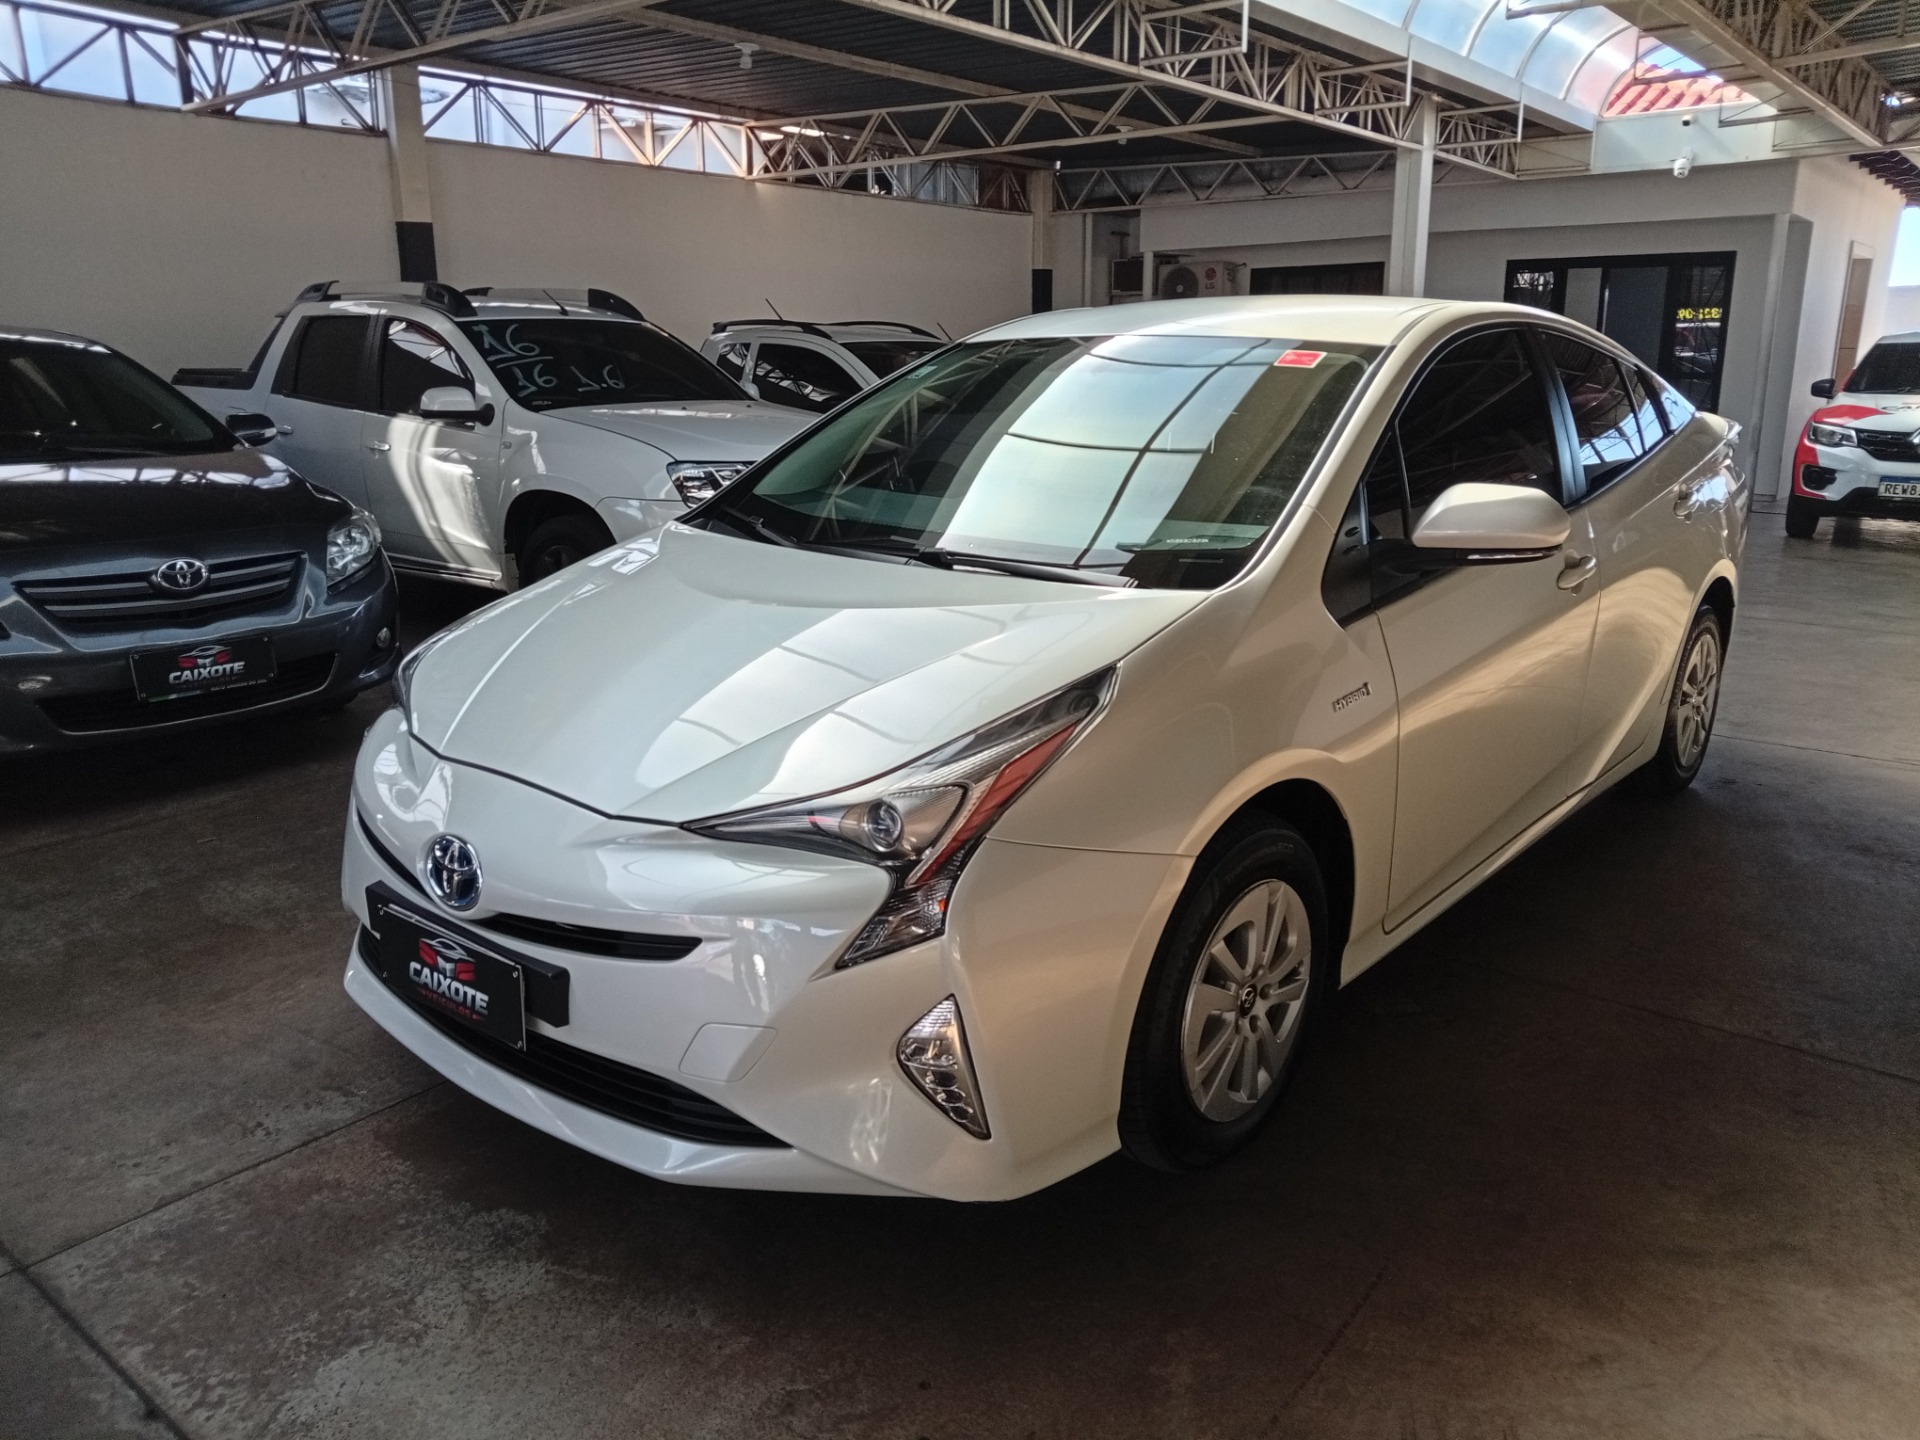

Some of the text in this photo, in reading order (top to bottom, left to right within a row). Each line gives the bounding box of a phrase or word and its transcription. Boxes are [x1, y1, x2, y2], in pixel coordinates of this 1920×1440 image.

[511, 363, 625, 397] 16 1.6
[1884, 483, 1920, 497] REW8
[168, 661, 245, 685] CAIXOTE
[1332, 683, 1370, 712] HYBRID
[409, 961, 489, 1015] CAIXOTE
